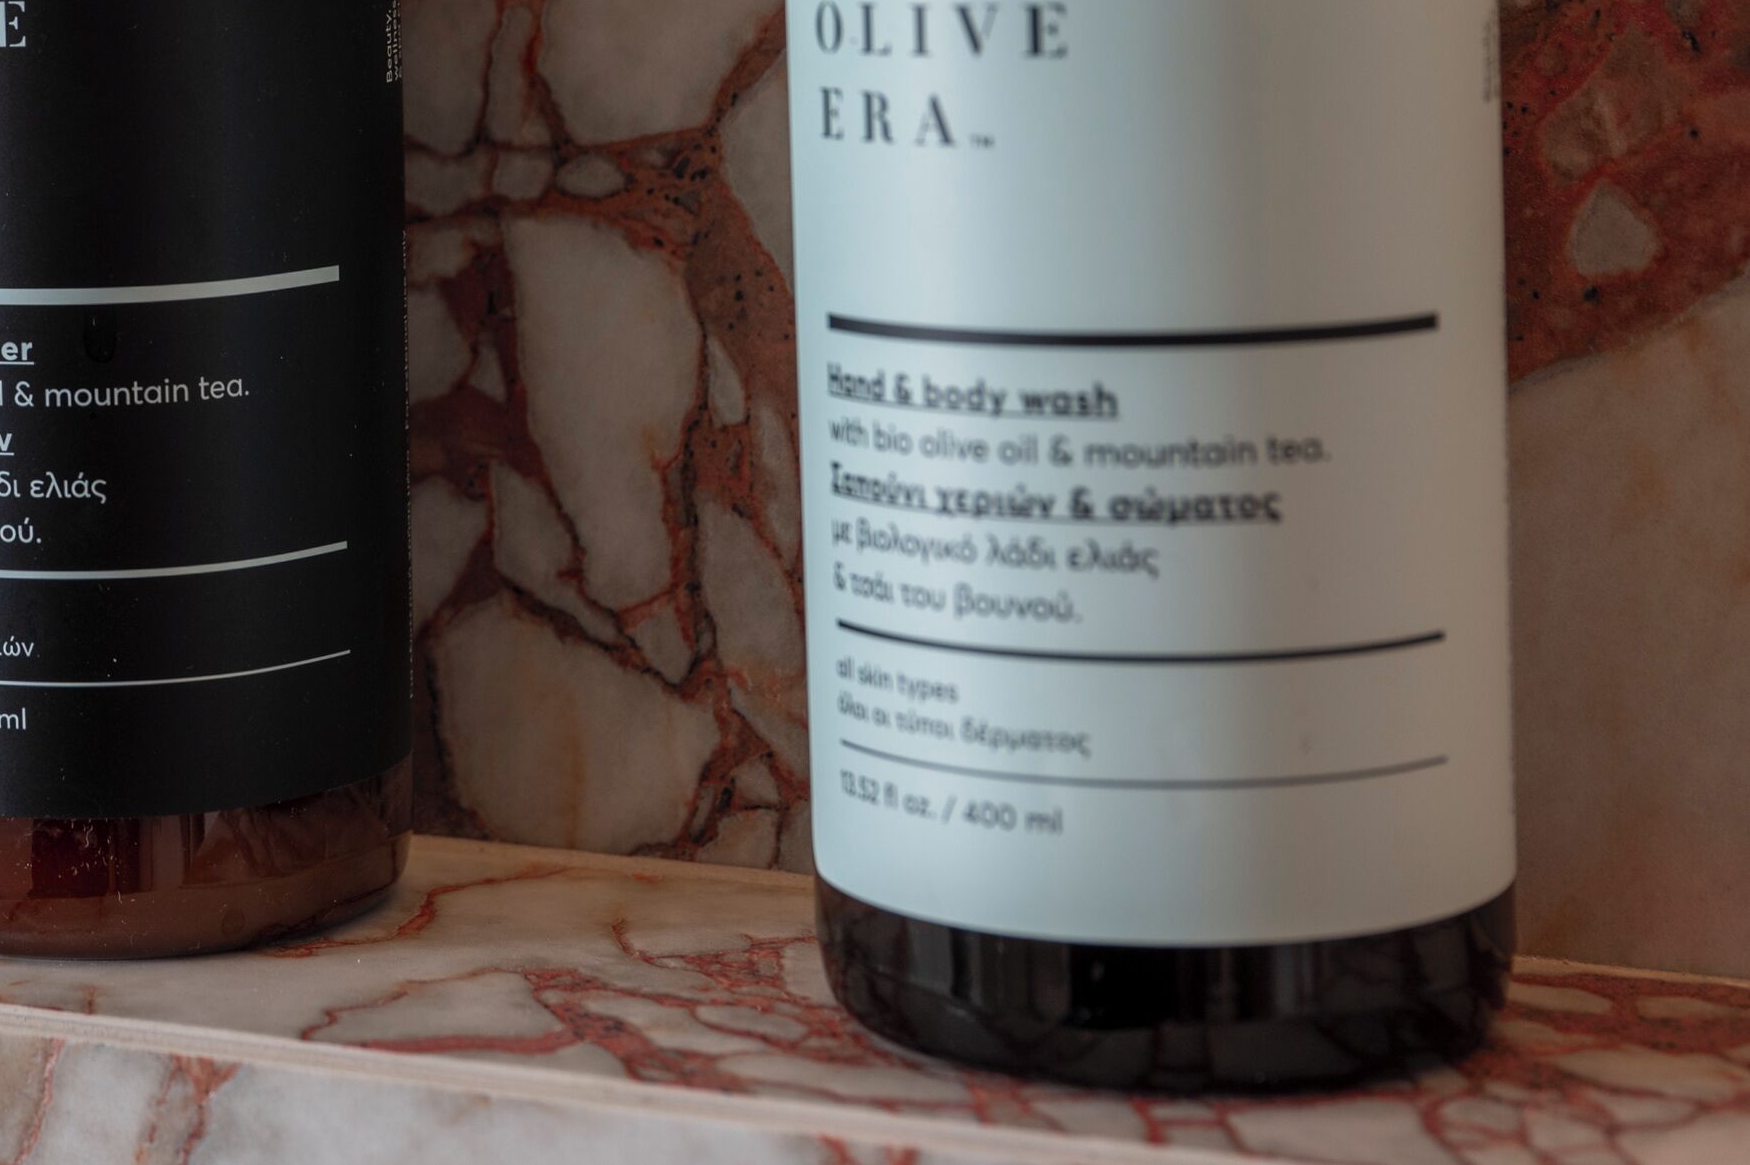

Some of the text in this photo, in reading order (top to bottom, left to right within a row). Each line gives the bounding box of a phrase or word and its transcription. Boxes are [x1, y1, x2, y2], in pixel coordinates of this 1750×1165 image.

[815, 0, 1069, 59] OLIVE
[820, 88, 956, 147] ERA
[14, 381, 34, 407] &
[45, 378, 189, 407] mountain
[199, 376, 250, 401] tea.
[827, 361, 1118, 417] Hand & body wash
[829, 417, 1333, 469] with bio olive oil & mountain tea.
[30, 471, 107, 504] ελιάς
[830, 460, 1283, 526] Σαπούνι χεριών & σώματος
[856, 516, 978, 563] βιολογικό
[985, 533, 1057, 570] λάδι
[1066, 538, 1160, 579] ελιάς
[900, 582, 946, 611] του
[953, 581, 1083, 622] βουνού.
[896, 672, 960, 704] types
[903, 793, 937, 820] oz.
[941, 794, 957, 825] /
[962, 800, 1017, 832] 400
[1024, 808, 1064, 834] ml
